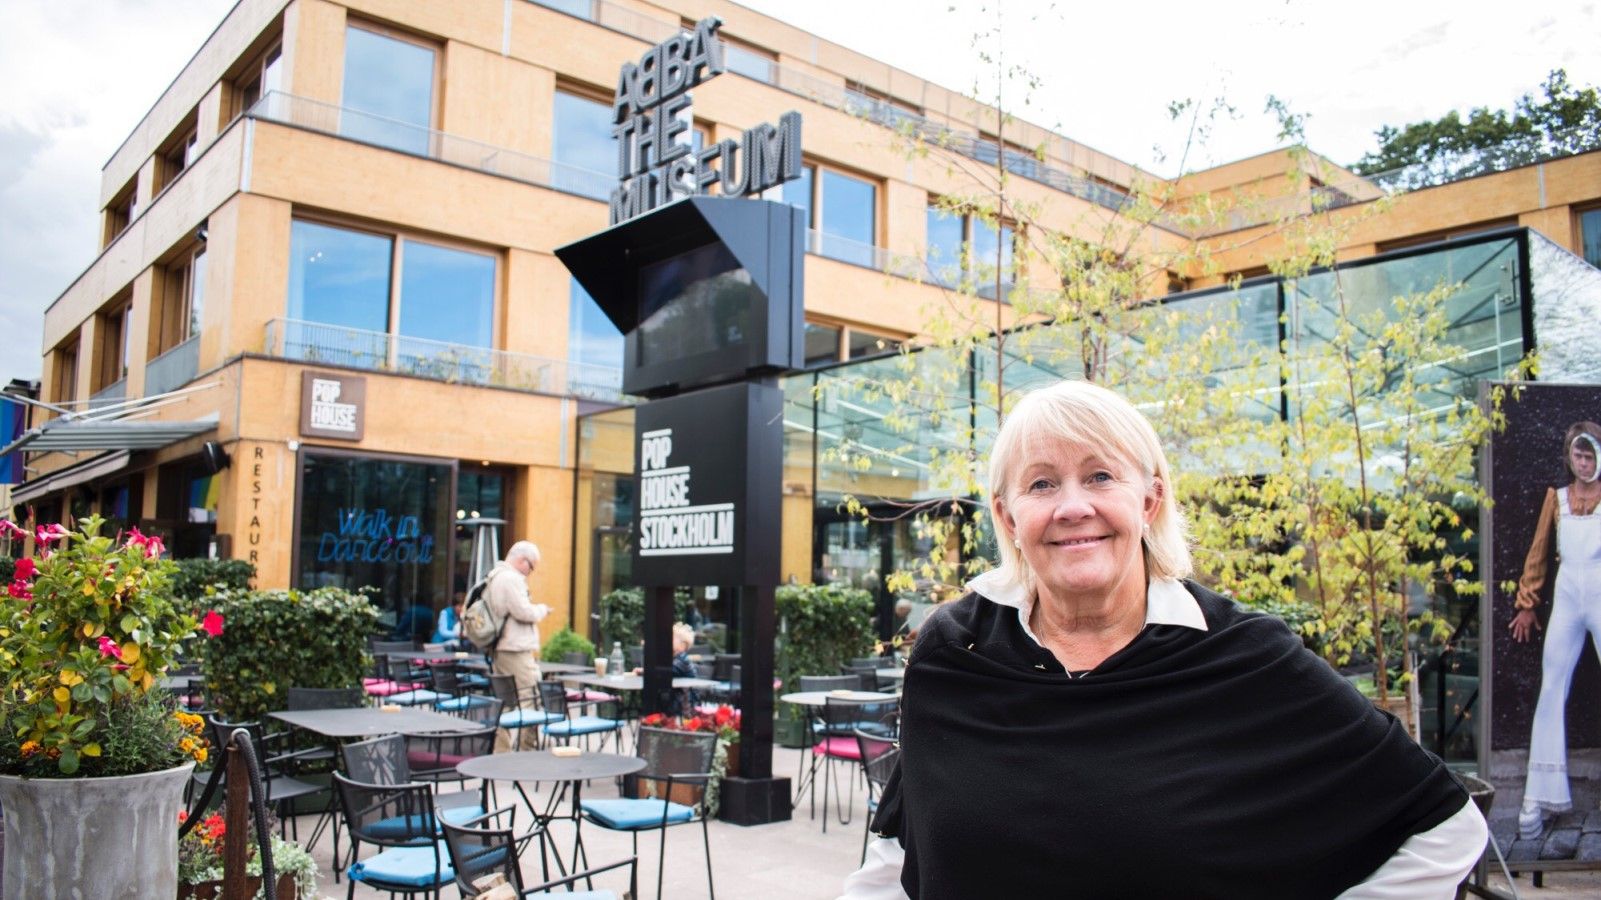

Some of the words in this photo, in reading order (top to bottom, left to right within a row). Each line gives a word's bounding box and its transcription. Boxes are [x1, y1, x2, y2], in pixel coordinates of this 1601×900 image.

[613, 16, 726, 124] ABBA
[612, 92, 693, 181] THE
[609, 110, 803, 226] MUSEUM
[312, 382, 341, 403] POP
[310, 403, 357, 428] HOUSE
[641, 436, 672, 470] POP
[640, 473, 690, 509] HOUSE
[317, 531, 393, 563] Dance
[639, 511, 734, 549] STOCKHOLM
